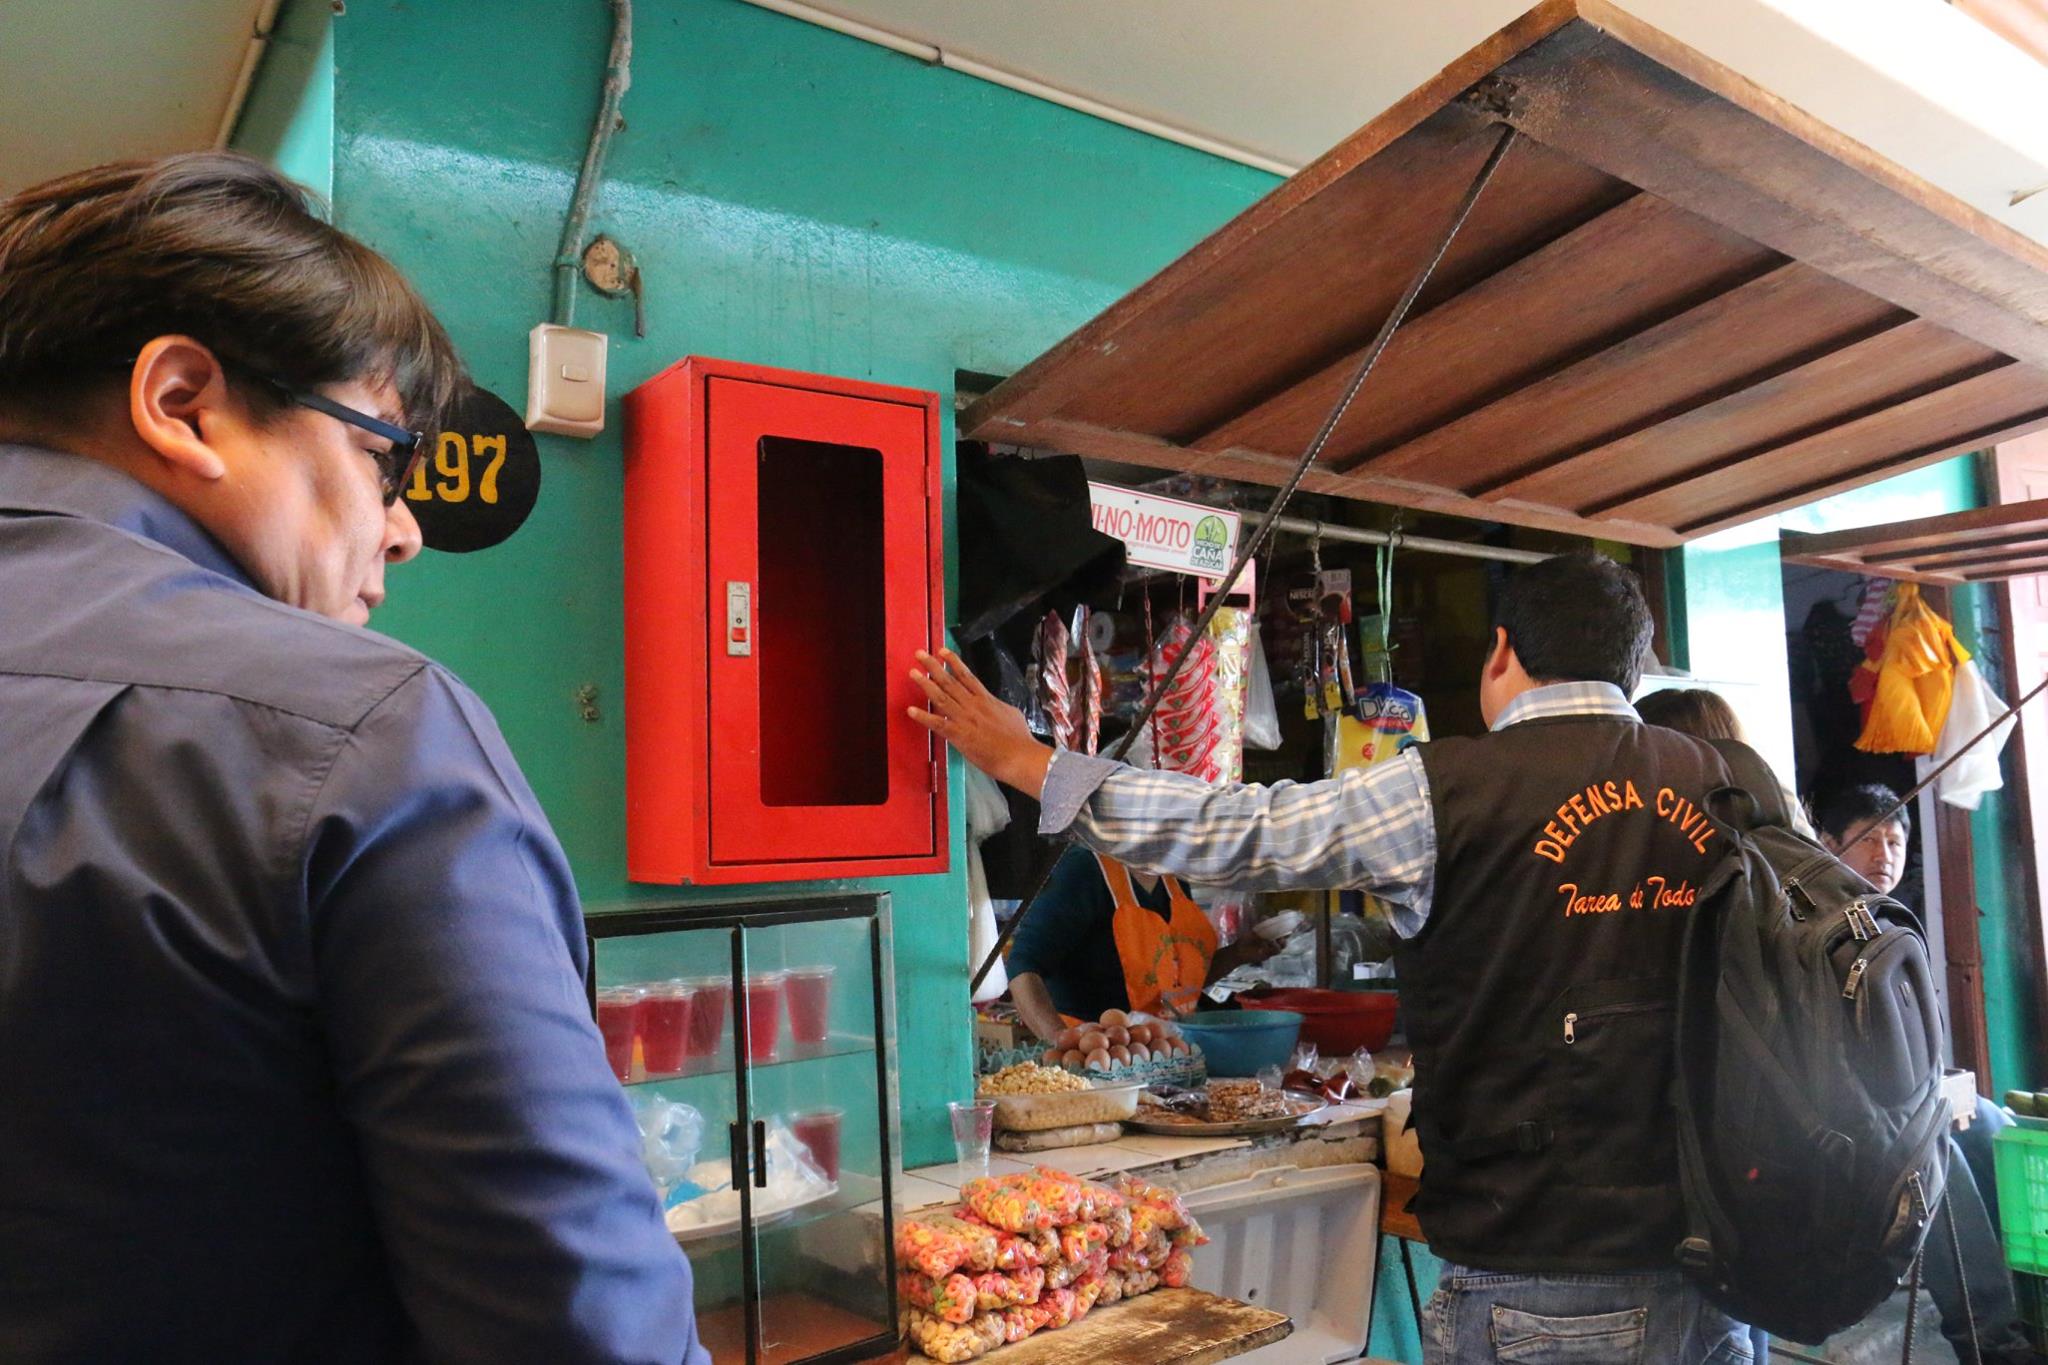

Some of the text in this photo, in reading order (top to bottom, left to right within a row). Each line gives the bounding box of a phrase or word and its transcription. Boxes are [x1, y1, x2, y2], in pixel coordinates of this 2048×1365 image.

[406, 432, 507, 504] 197
[1193, 546, 1223, 562] CAÑA
[1534, 780, 1716, 864] DEFENSA CIVIL
[1558, 876, 1702, 917] Tarea de Todo
